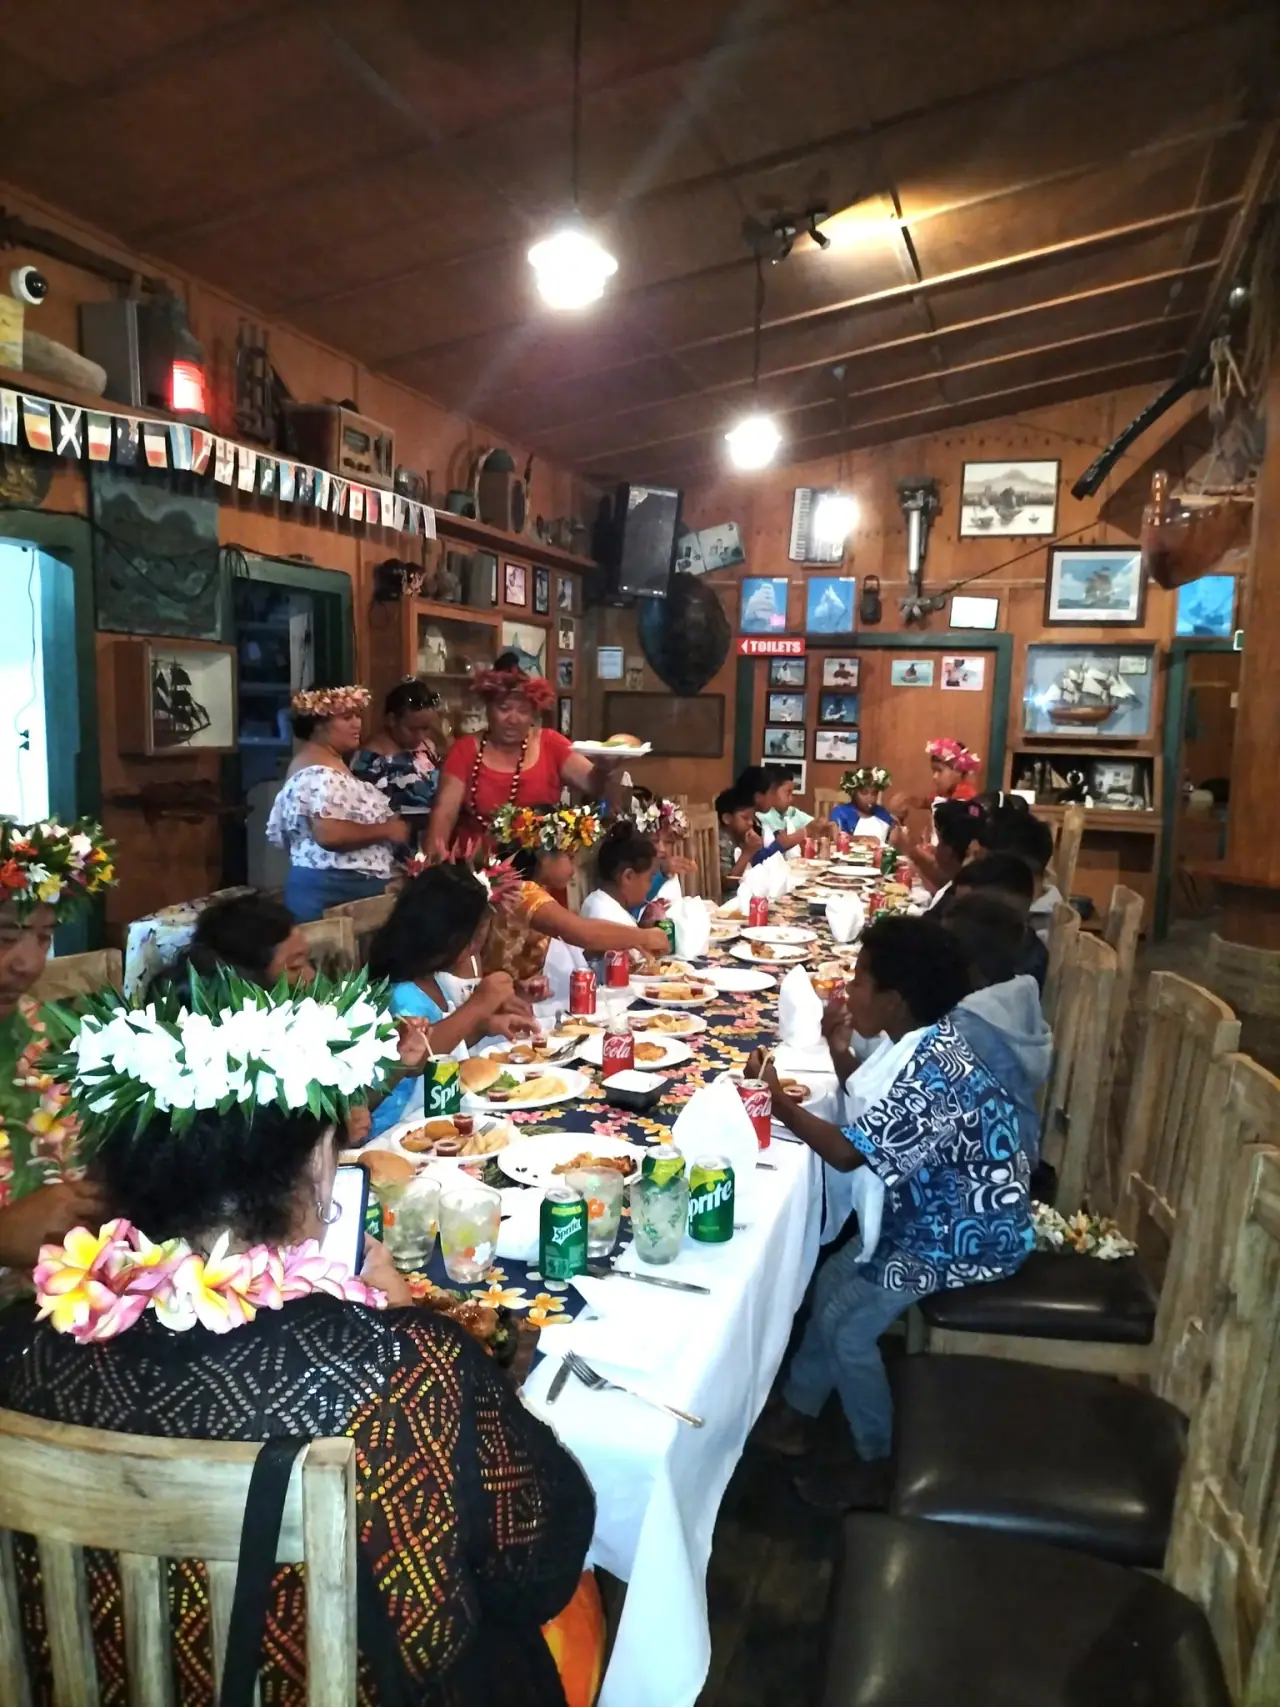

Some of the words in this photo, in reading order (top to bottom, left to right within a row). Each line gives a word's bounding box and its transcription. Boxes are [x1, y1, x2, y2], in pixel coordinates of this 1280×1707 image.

[750, 640, 801, 653] TOILETS
[603, 1036, 632, 1059] Cola
[688, 1180, 732, 1223] prite
[555, 1221, 580, 1241] Sprite
